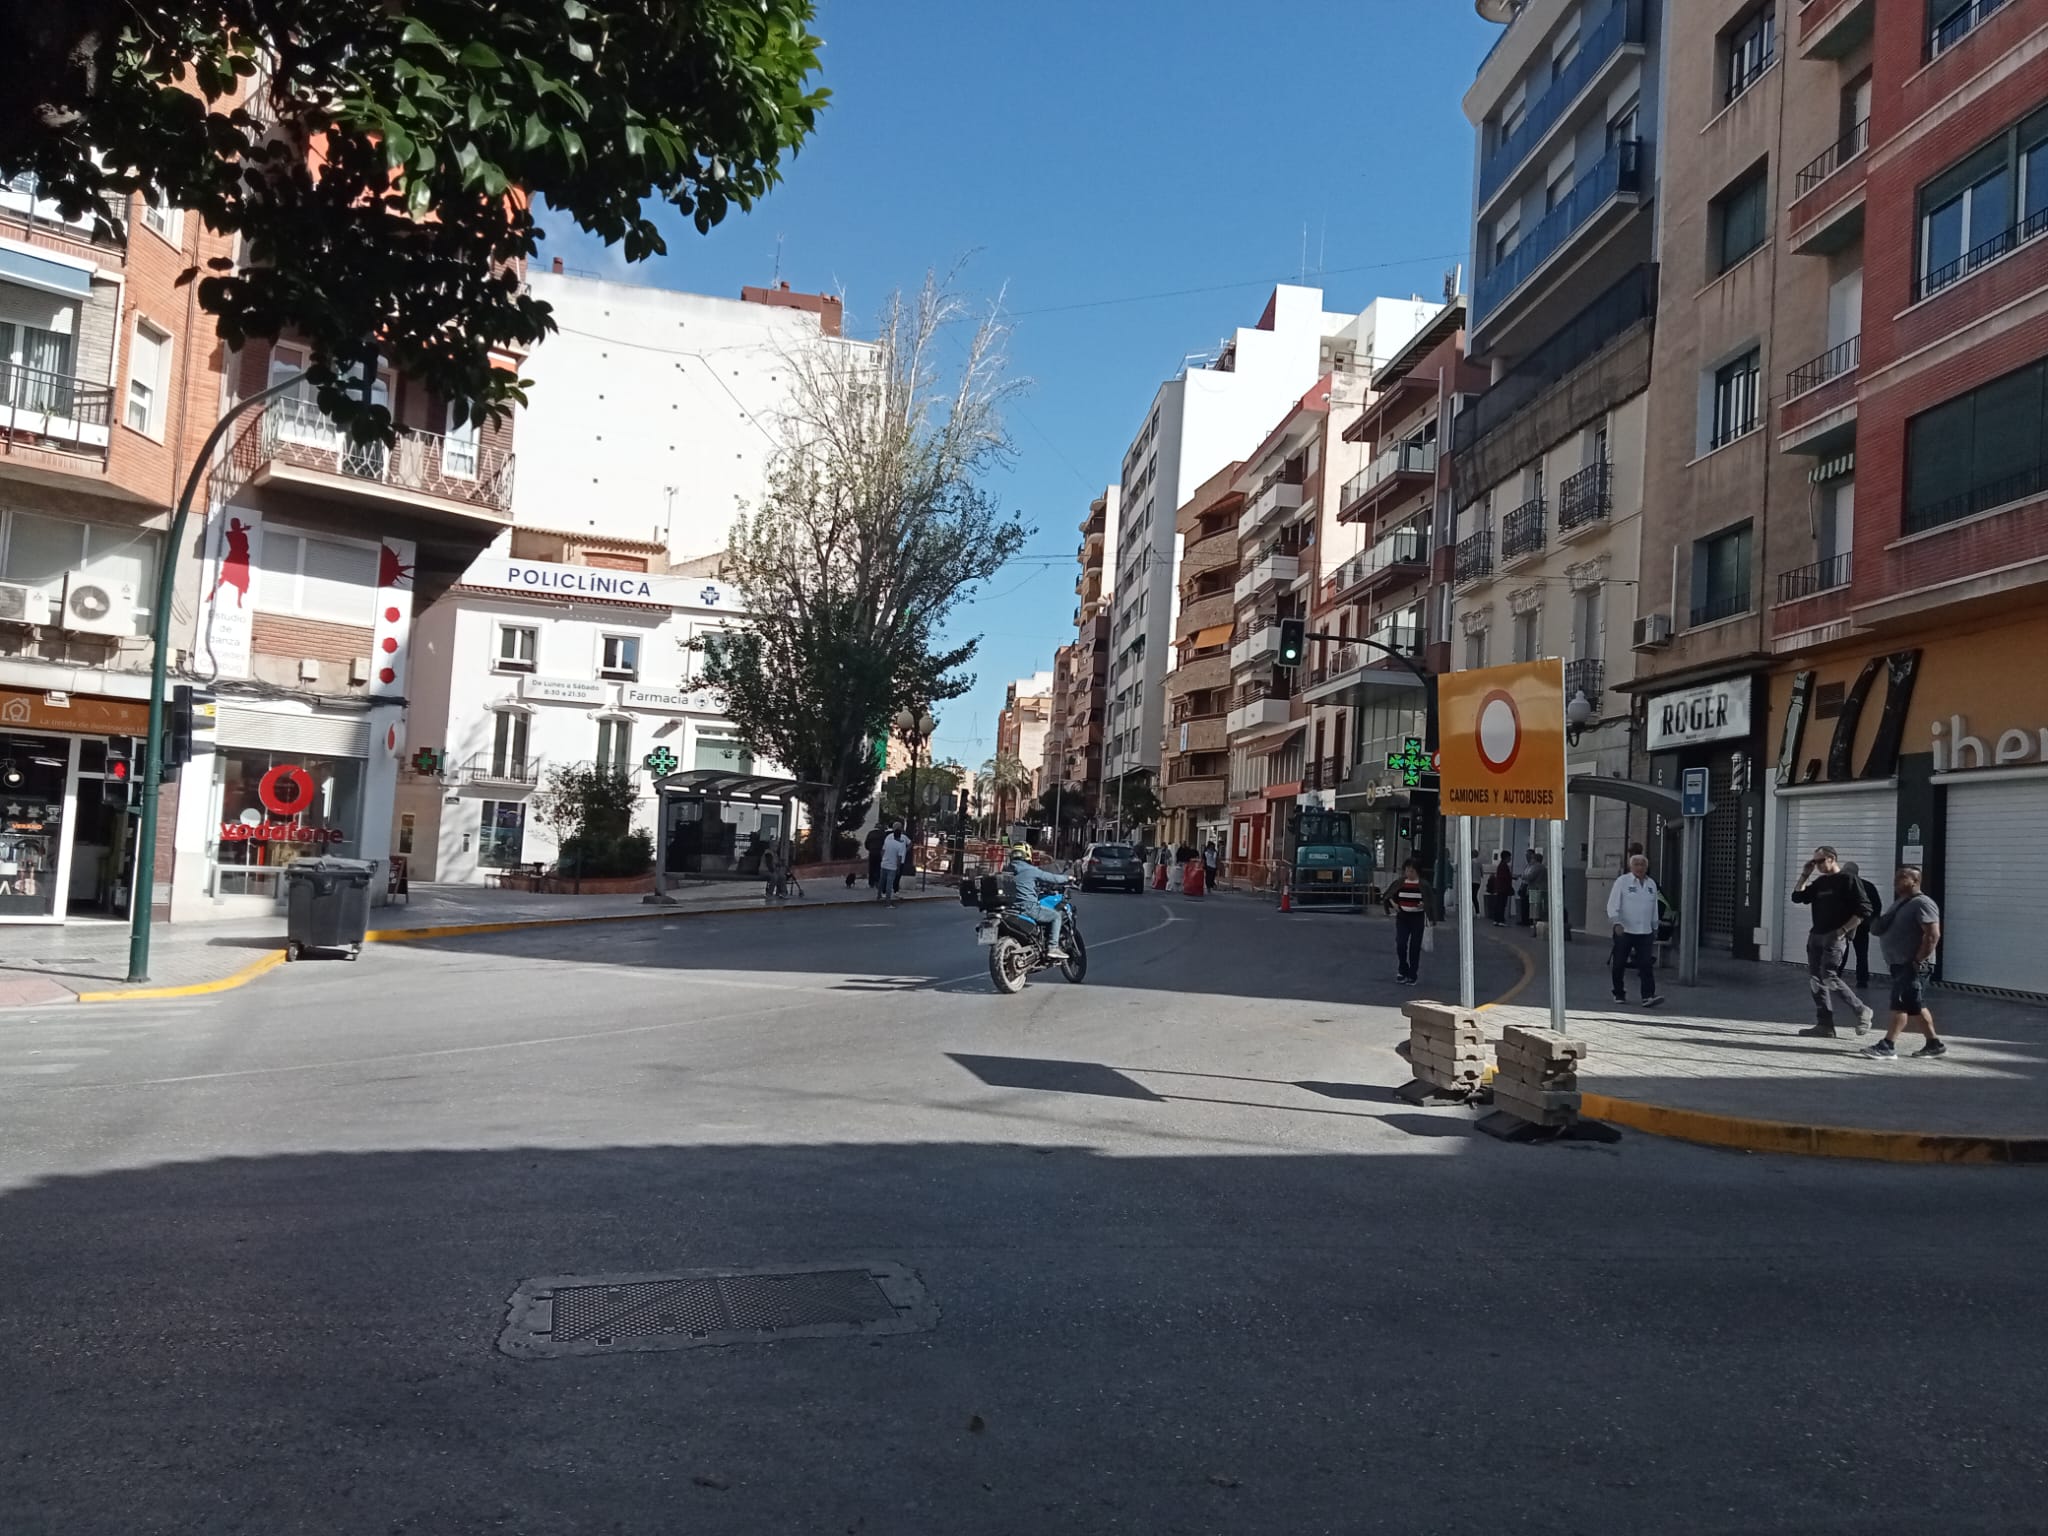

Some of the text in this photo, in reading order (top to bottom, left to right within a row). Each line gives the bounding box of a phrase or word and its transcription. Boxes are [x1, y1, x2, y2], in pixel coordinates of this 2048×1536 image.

[508, 567, 652, 597] POLICLÍNICA
[629, 690, 689, 705] Farmacia
[1662, 693, 1729, 736] ROGER
[1449, 788, 1554, 805] CAMIONES Y AUTOBUSES
[220, 820, 344, 844] vodafone
